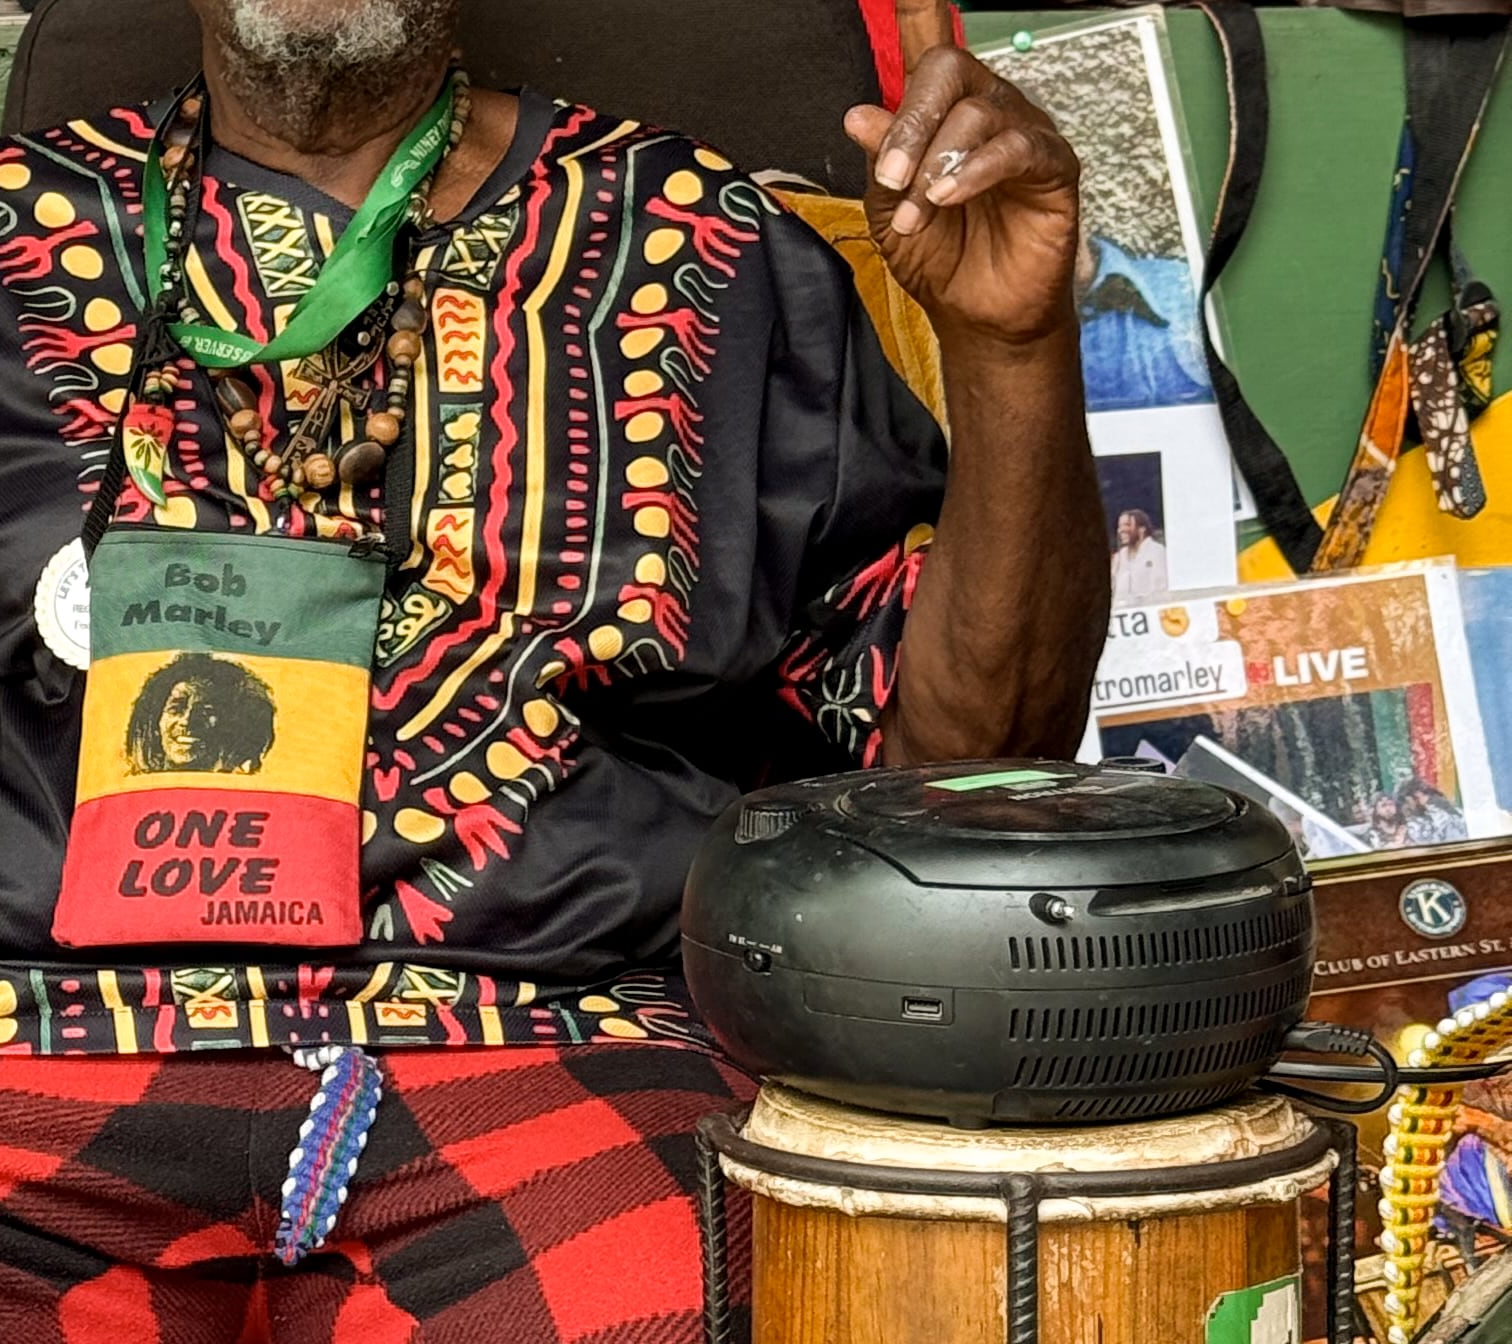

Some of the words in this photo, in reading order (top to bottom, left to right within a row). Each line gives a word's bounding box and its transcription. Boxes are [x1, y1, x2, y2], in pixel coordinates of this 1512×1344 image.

[164, 562, 247, 599] Bob
[121, 601, 282, 647] Marley
[1273, 647, 1369, 687] LIVE
[134, 808, 269, 849] ONE
[118, 857, 281, 899] LOVE
[199, 898, 324, 927] JAMAICA
[1314, 958, 1364, 976] CLUB
[1366, 954, 1391, 970] OF
[1394, 941, 1477, 966] EASTERN
